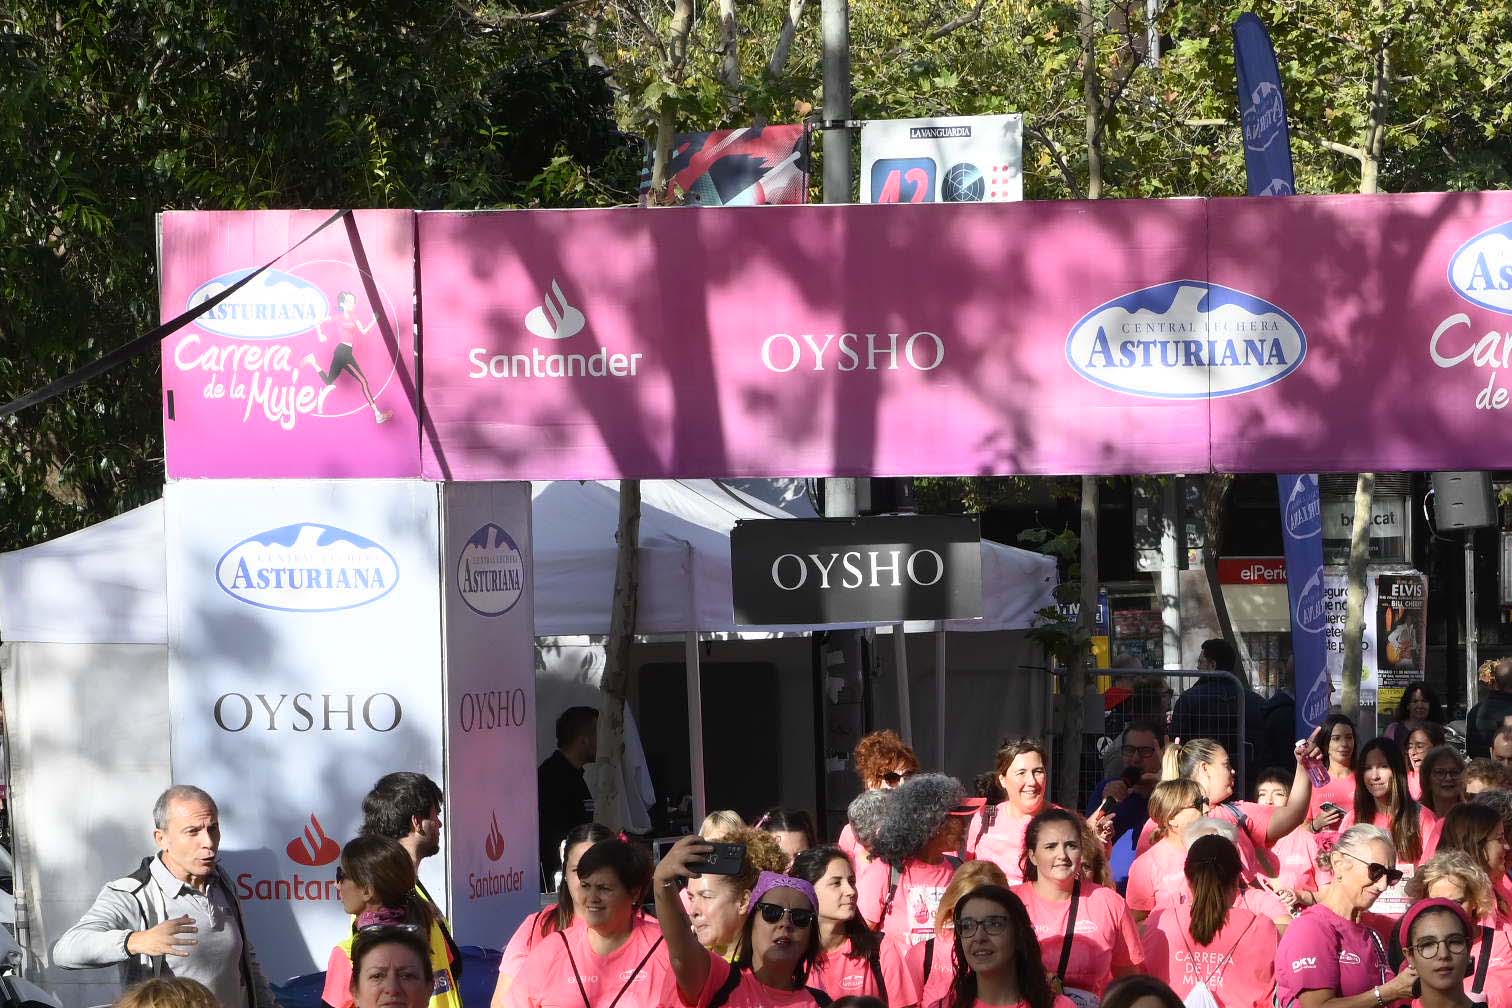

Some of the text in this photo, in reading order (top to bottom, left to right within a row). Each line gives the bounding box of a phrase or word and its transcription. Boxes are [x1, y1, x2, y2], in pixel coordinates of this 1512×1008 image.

[1121, 320, 1280, 335] CENTRAL LECHERA
[174, 333, 290, 372] Carrera
[468, 347, 643, 379] Santander
[760, 331, 945, 373] OYSHO
[1084, 325, 1288, 368] ASTURIANA
[203, 367, 337, 430] de la Mujer
[1475, 371, 1510, 410] de
[231, 555, 386, 590] ASTURIANA
[462, 558, 520, 593] ASTURIANA
[771, 549, 945, 592] OYSHO
[1391, 583, 1422, 597] ELVIS
[213, 692, 402, 733] OYSHO
[460, 688, 526, 733] OYSHO
[468, 868, 525, 900] Santander
[1175, 950, 1236, 966] CARRERA
[1185, 964, 1222, 975] DE LA
[1291, 956, 1317, 970] DKV
